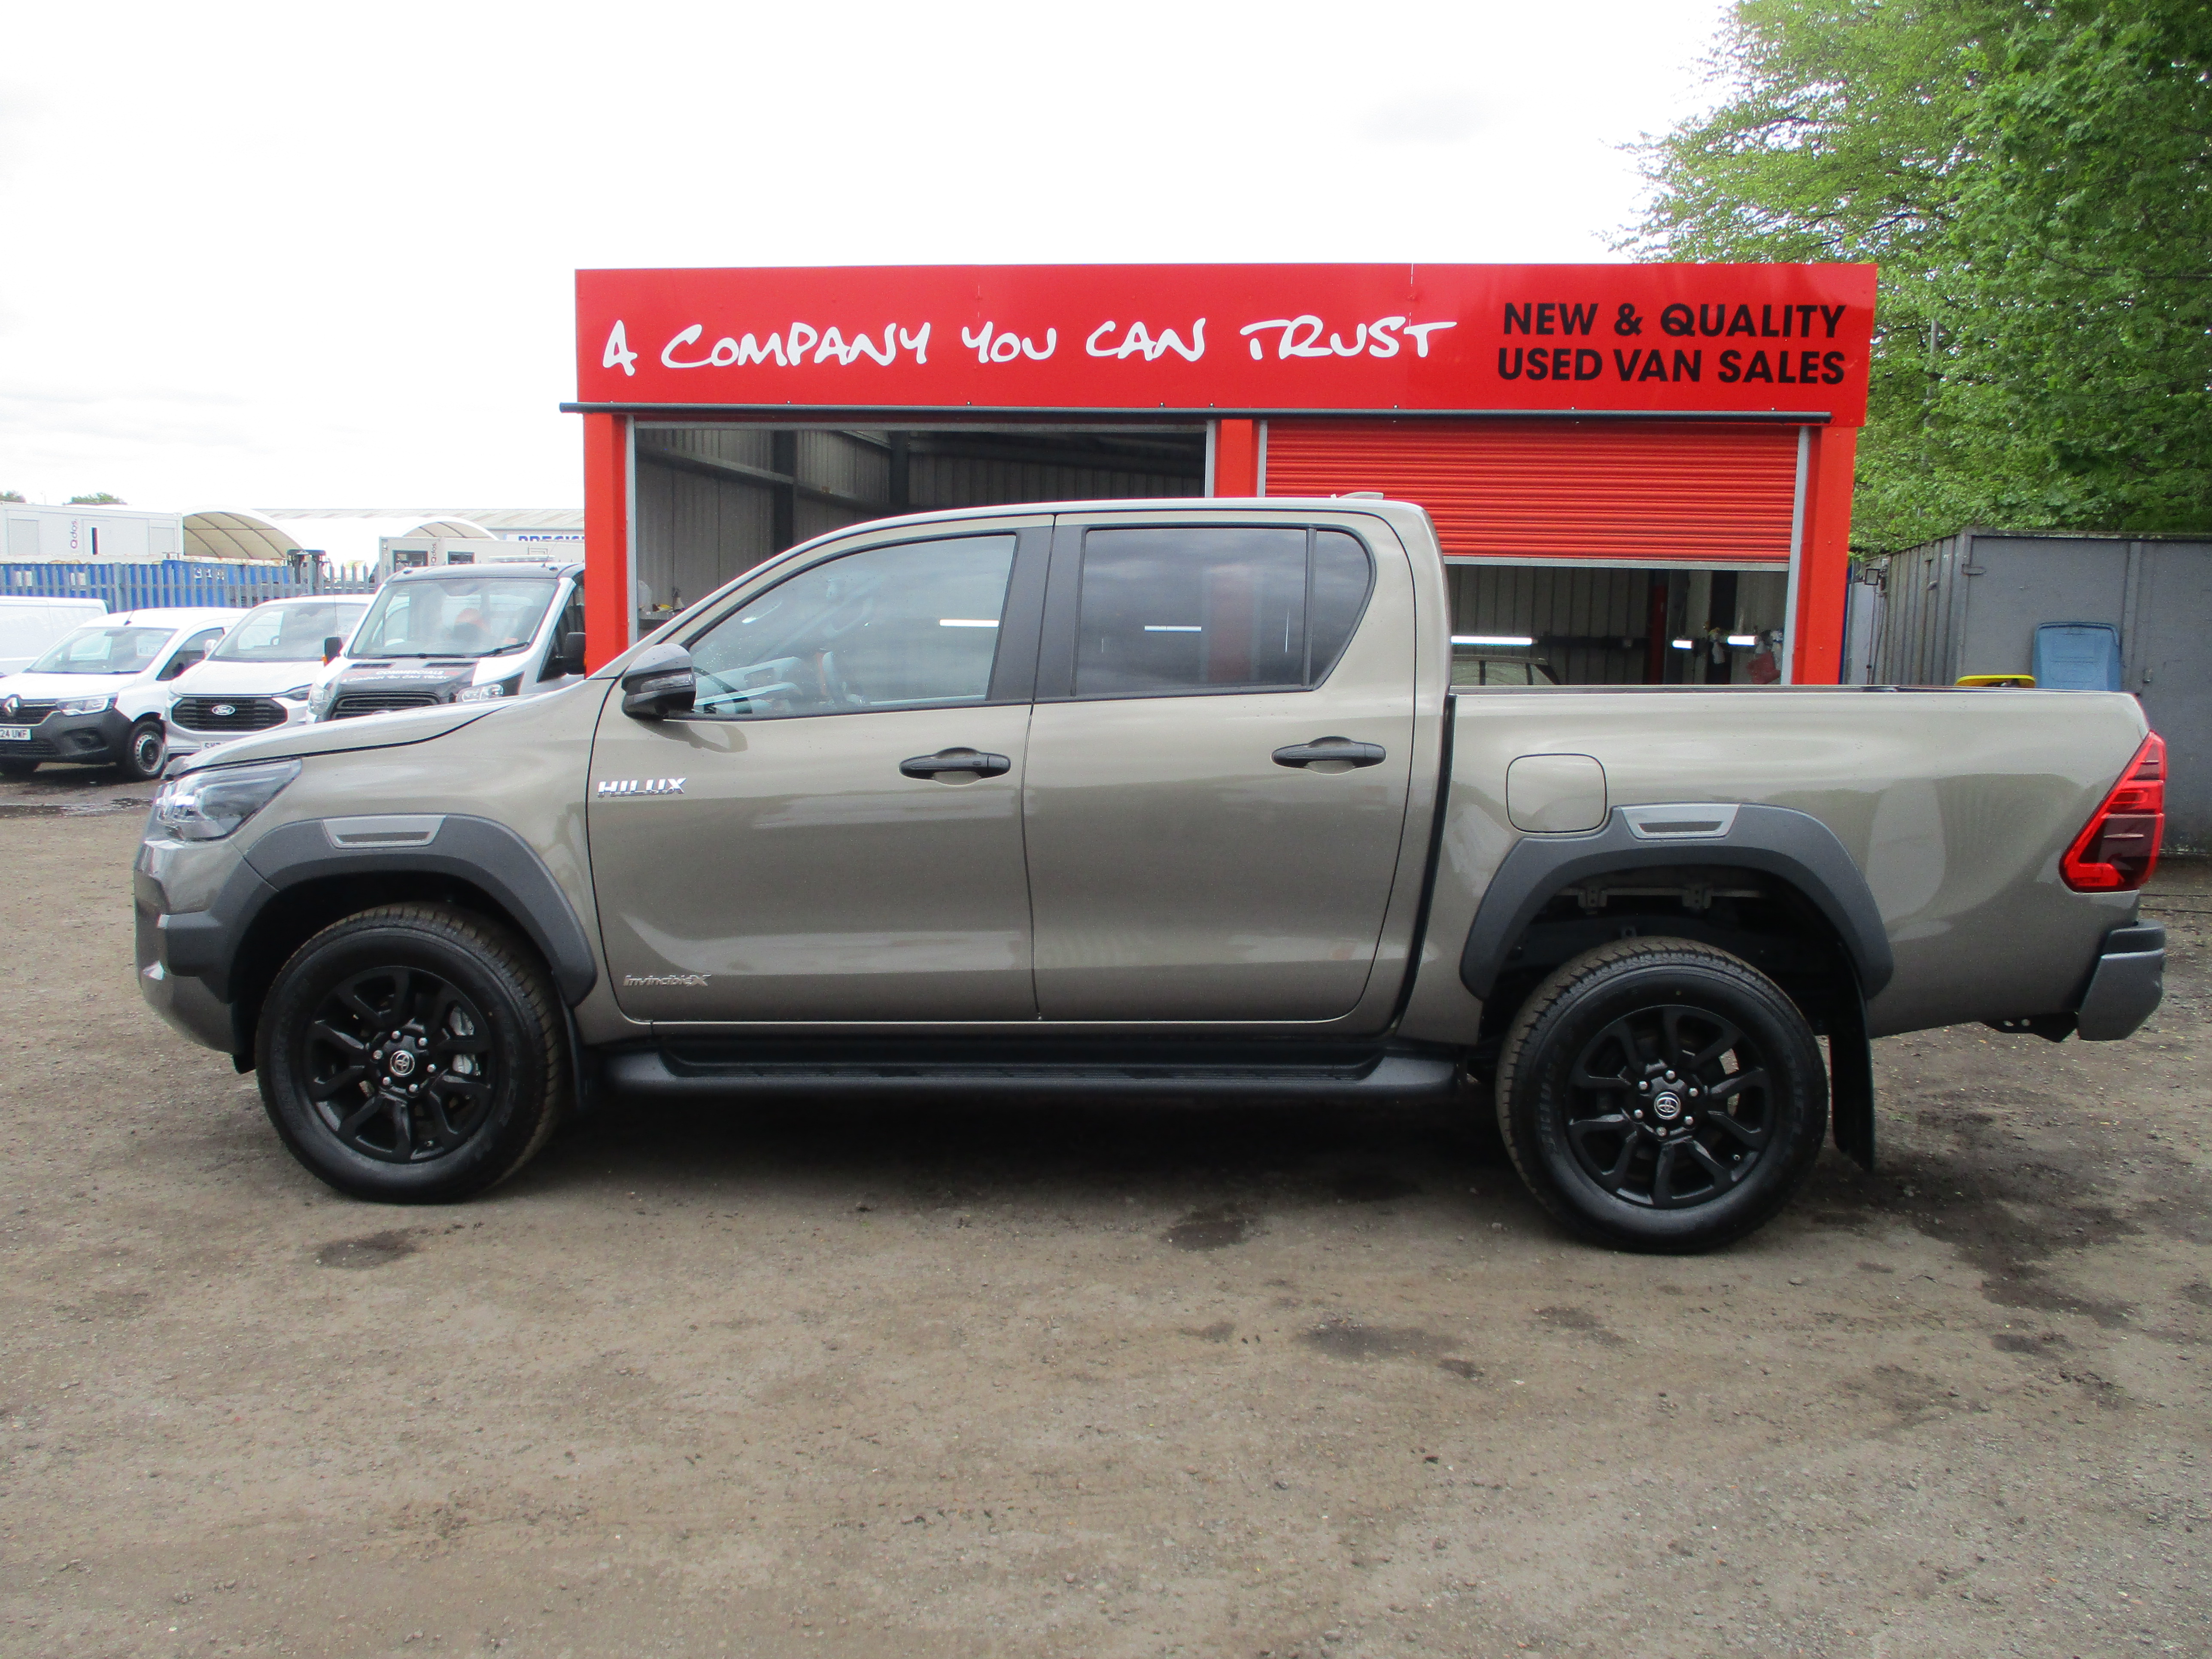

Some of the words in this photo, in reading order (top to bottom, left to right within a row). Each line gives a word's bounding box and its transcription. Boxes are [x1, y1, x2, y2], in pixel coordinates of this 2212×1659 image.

[1504, 303, 1598, 335] NEW
[1613, 303, 1643, 336] &
[1660, 303, 1846, 338] QUALITY
[602, 319, 638, 376] A
[661, 322, 931, 368] COMPANY
[961, 321, 1057, 363] YOU
[1086, 318, 1206, 362] CAN
[1240, 315, 1457, 360] TRUST
[1498, 347, 1602, 381] USED
[1613, 349, 1702, 382] VAN
[1718, 349, 1845, 385] SALES
[597, 778, 687, 798] HILUX
